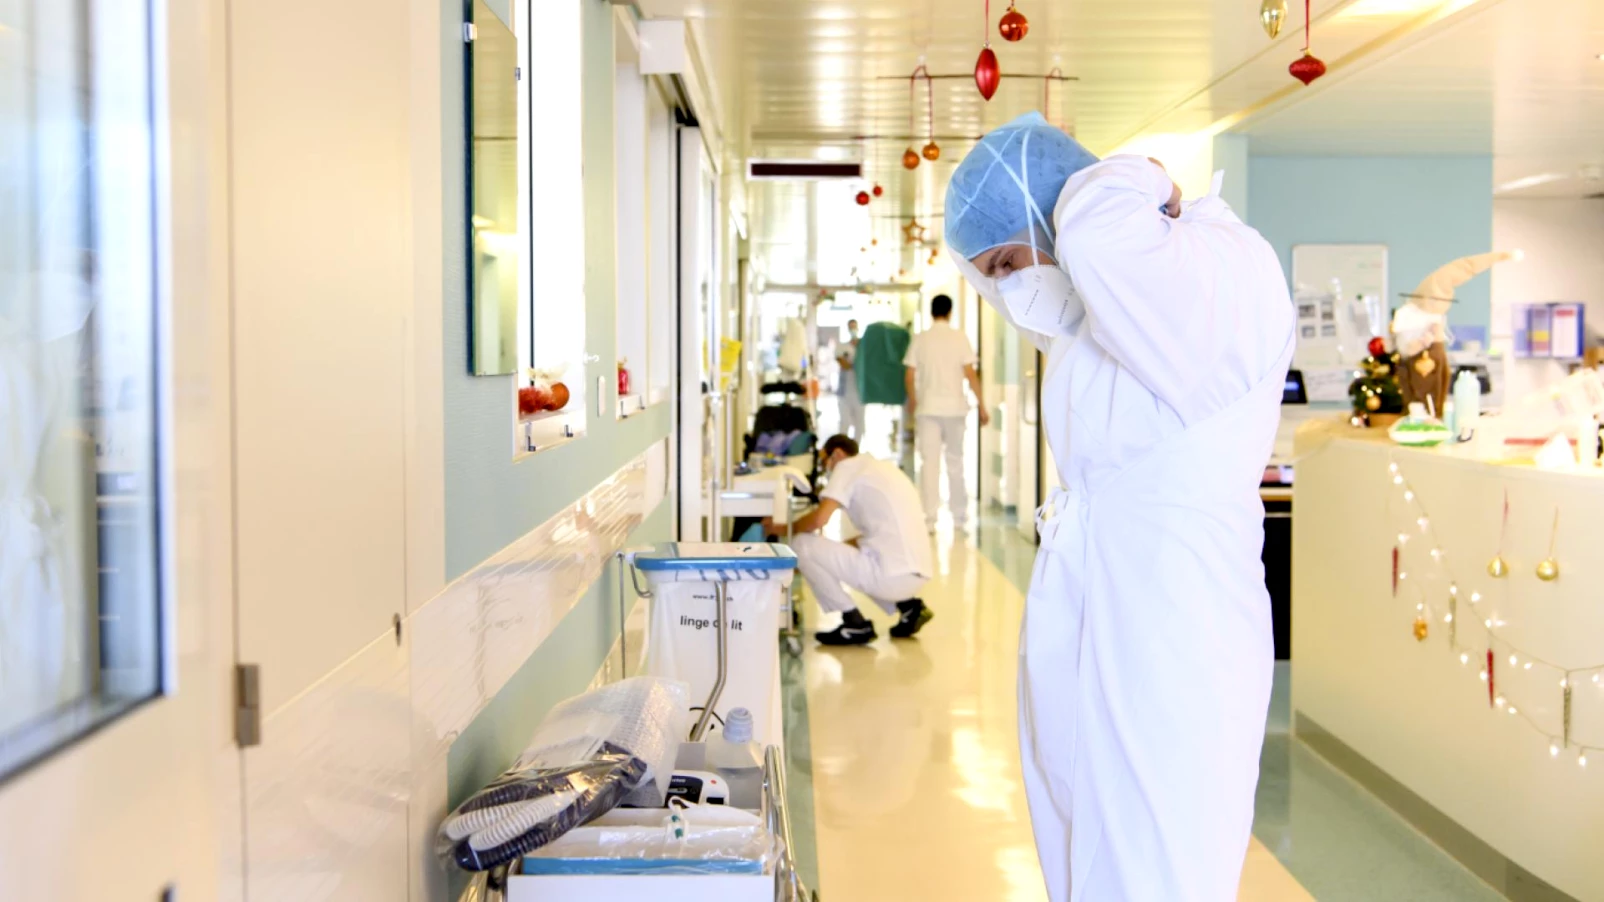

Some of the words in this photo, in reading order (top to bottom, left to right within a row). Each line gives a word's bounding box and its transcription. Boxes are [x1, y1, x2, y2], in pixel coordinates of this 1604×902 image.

[680, 615, 710, 630] linge
[712, 616, 728, 629] d
[731, 619, 742, 631] lit
